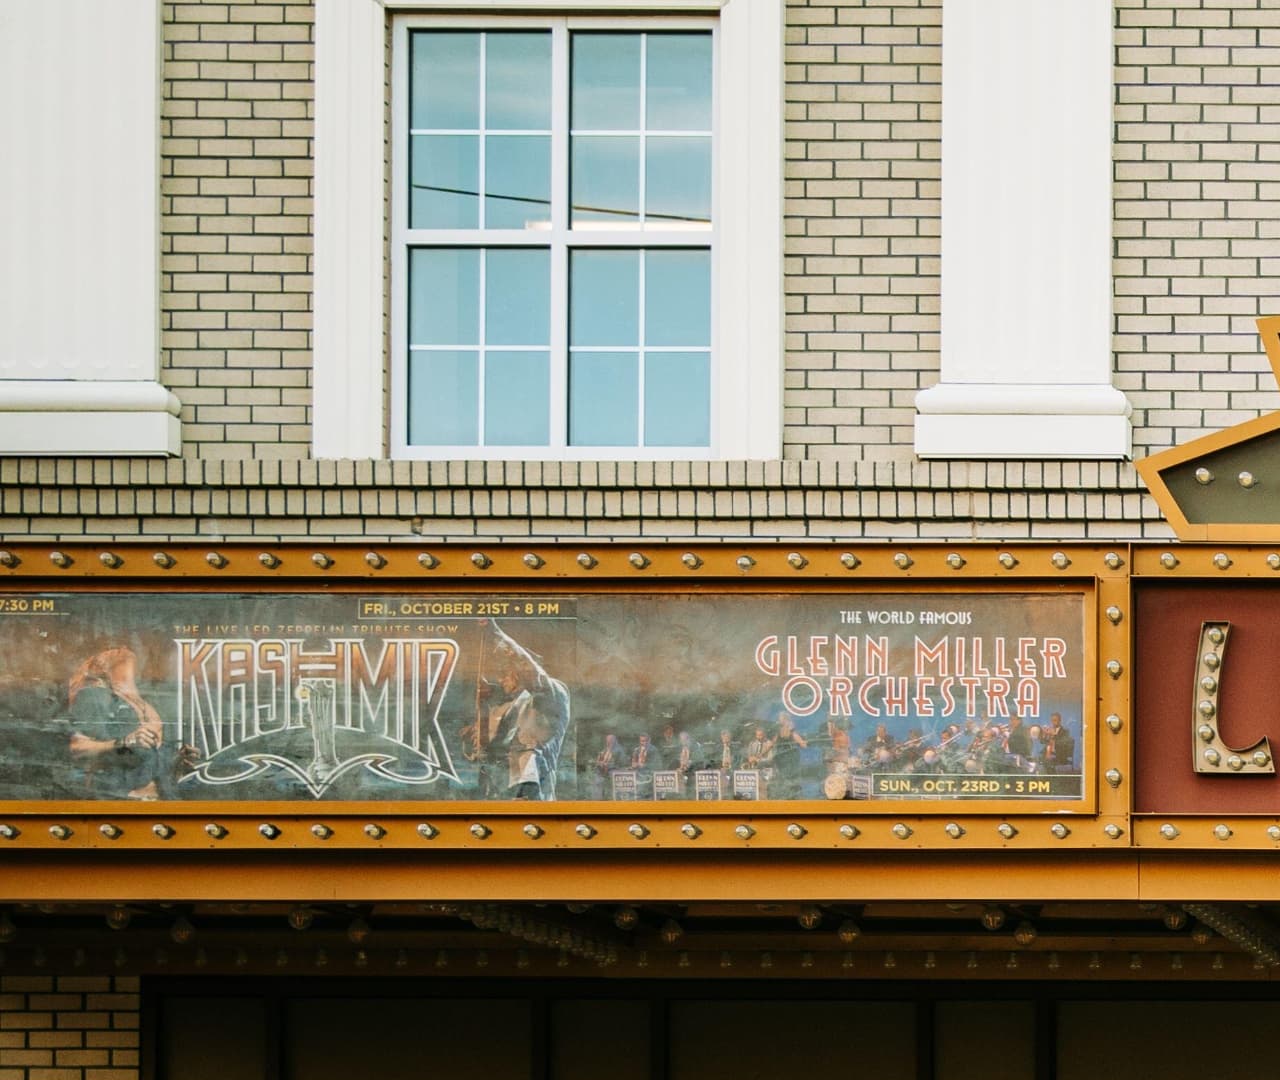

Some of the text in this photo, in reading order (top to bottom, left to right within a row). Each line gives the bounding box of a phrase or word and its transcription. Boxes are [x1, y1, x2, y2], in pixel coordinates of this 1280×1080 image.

[33, 600, 54, 611] PM
[364, 603, 560, 616] FRI., OCTOBER 21ST 8 PM
[840, 611, 972, 625] THE WORLD FAMOUS
[174, 625, 199, 634] THE
[418, 625, 458, 634] SHOW
[755, 634, 1067, 679] GLENN MILLER
[781, 676, 1041, 718] ORCHESTRA
[174, 638, 461, 784] KASHMIR
[880, 780, 917, 795] SUN.,
[923, 780, 957, 795] OCT.
[962, 780, 1000, 795] 23RD
[1015, 780, 1024, 795] 3
[1028, 780, 1051, 795] PM
